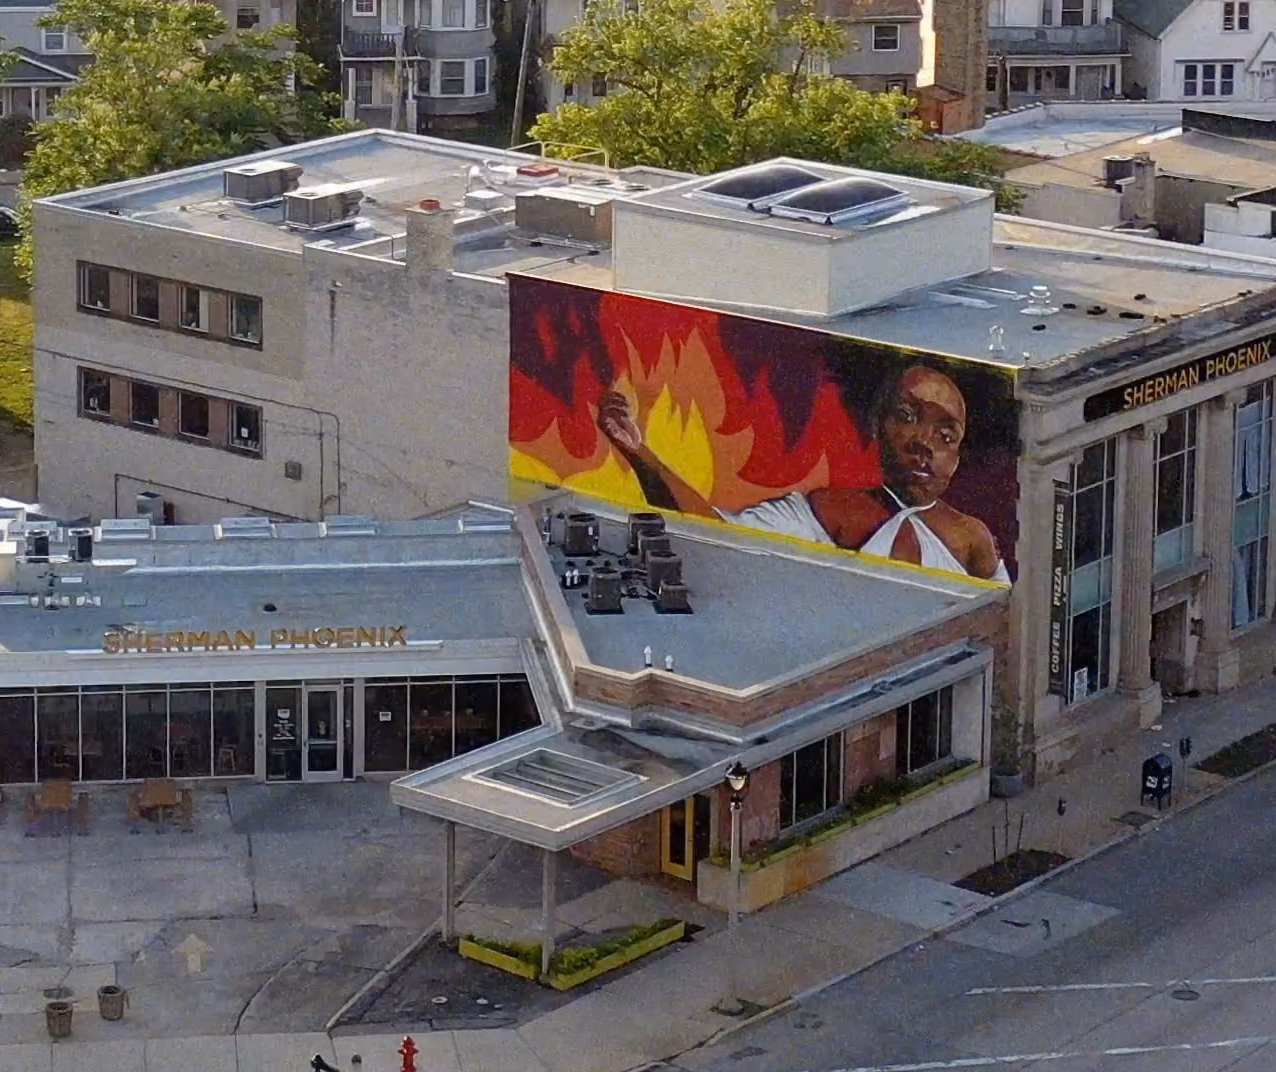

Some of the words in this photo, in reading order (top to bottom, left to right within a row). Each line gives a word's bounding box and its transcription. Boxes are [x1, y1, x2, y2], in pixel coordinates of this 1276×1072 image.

[1123, 364, 1201, 410] SHERMAN
[1205, 339, 1273, 381] PHOENIX
[1055, 503, 1065, 550] WINGS
[1053, 567, 1063, 607] PIZZA
[102, 629, 256, 654] SHERMAN
[270, 625, 407, 649] PHOENIX
[1051, 622, 1061, 674] COFFEE
